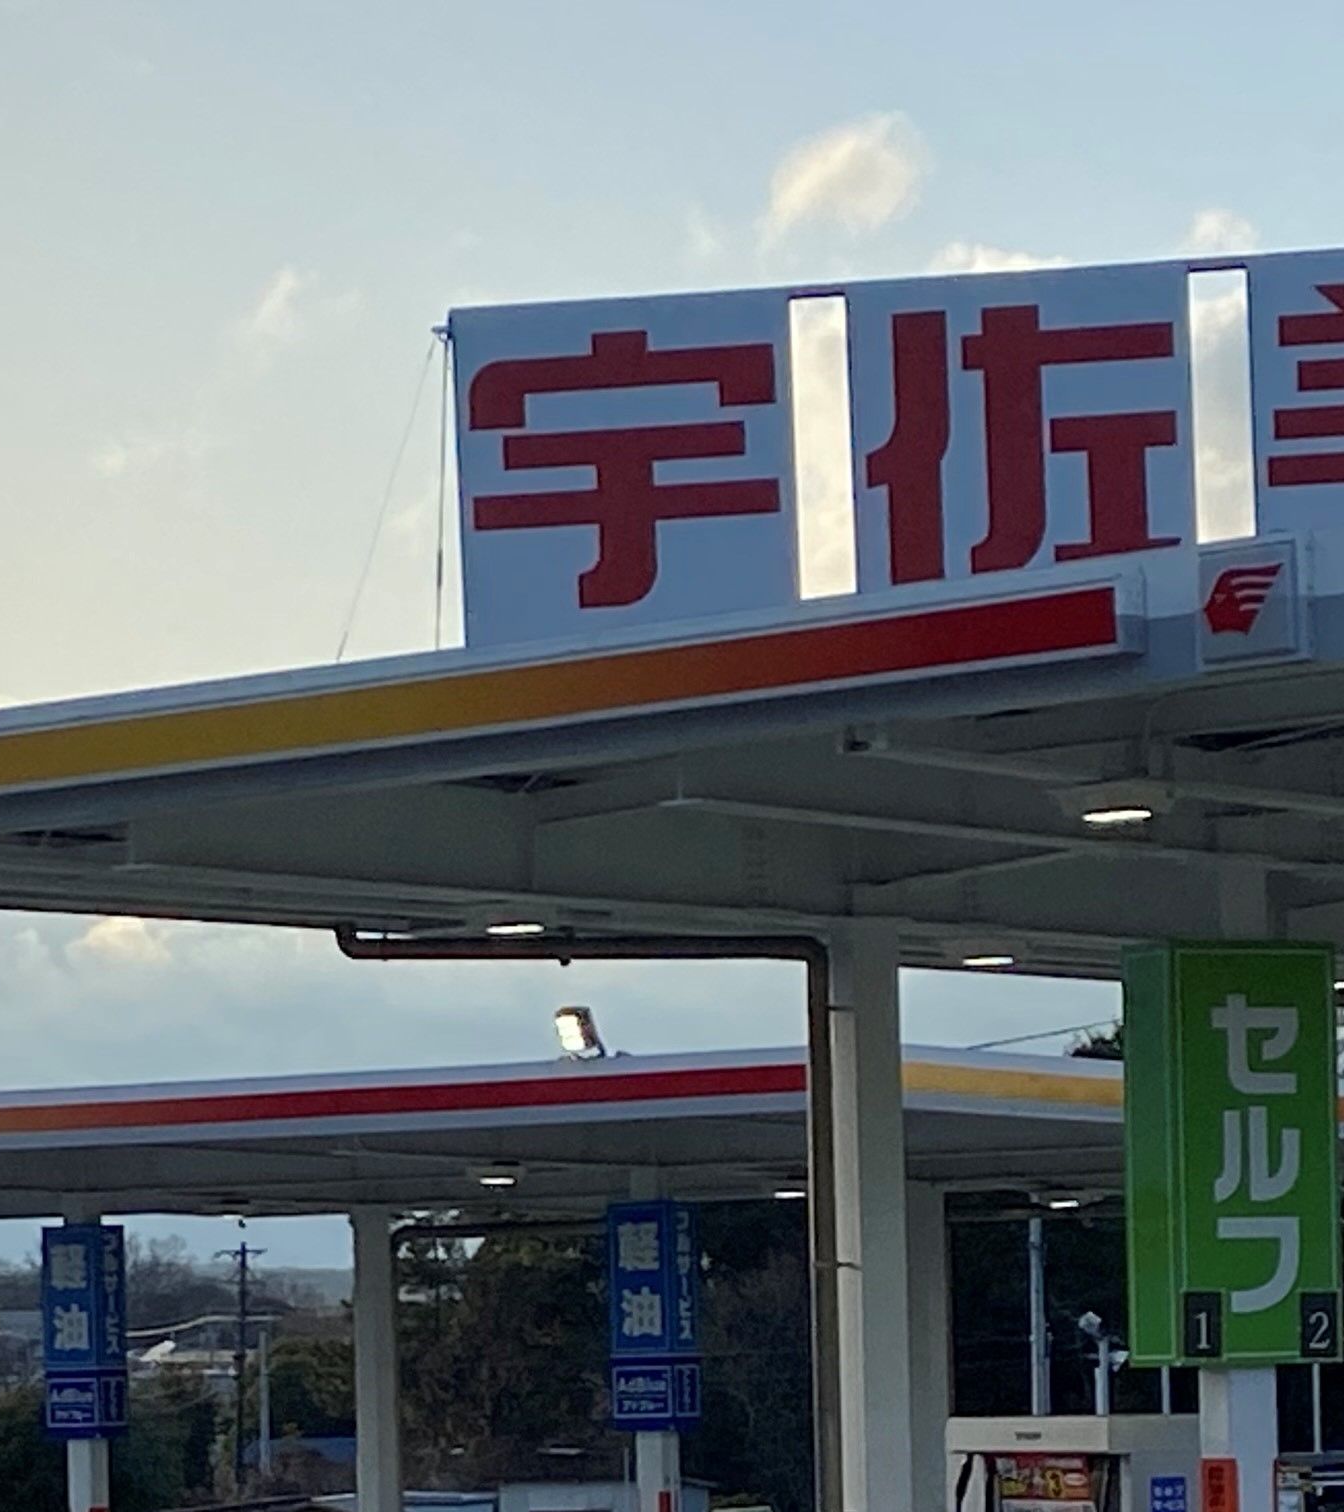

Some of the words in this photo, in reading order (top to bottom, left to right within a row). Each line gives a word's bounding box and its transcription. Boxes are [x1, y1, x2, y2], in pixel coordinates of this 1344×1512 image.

[1210, 992, 1302, 1314] セルフ
[1195, 1310, 1212, 1351] 1
[1308, 1309, 1332, 1350] 2
